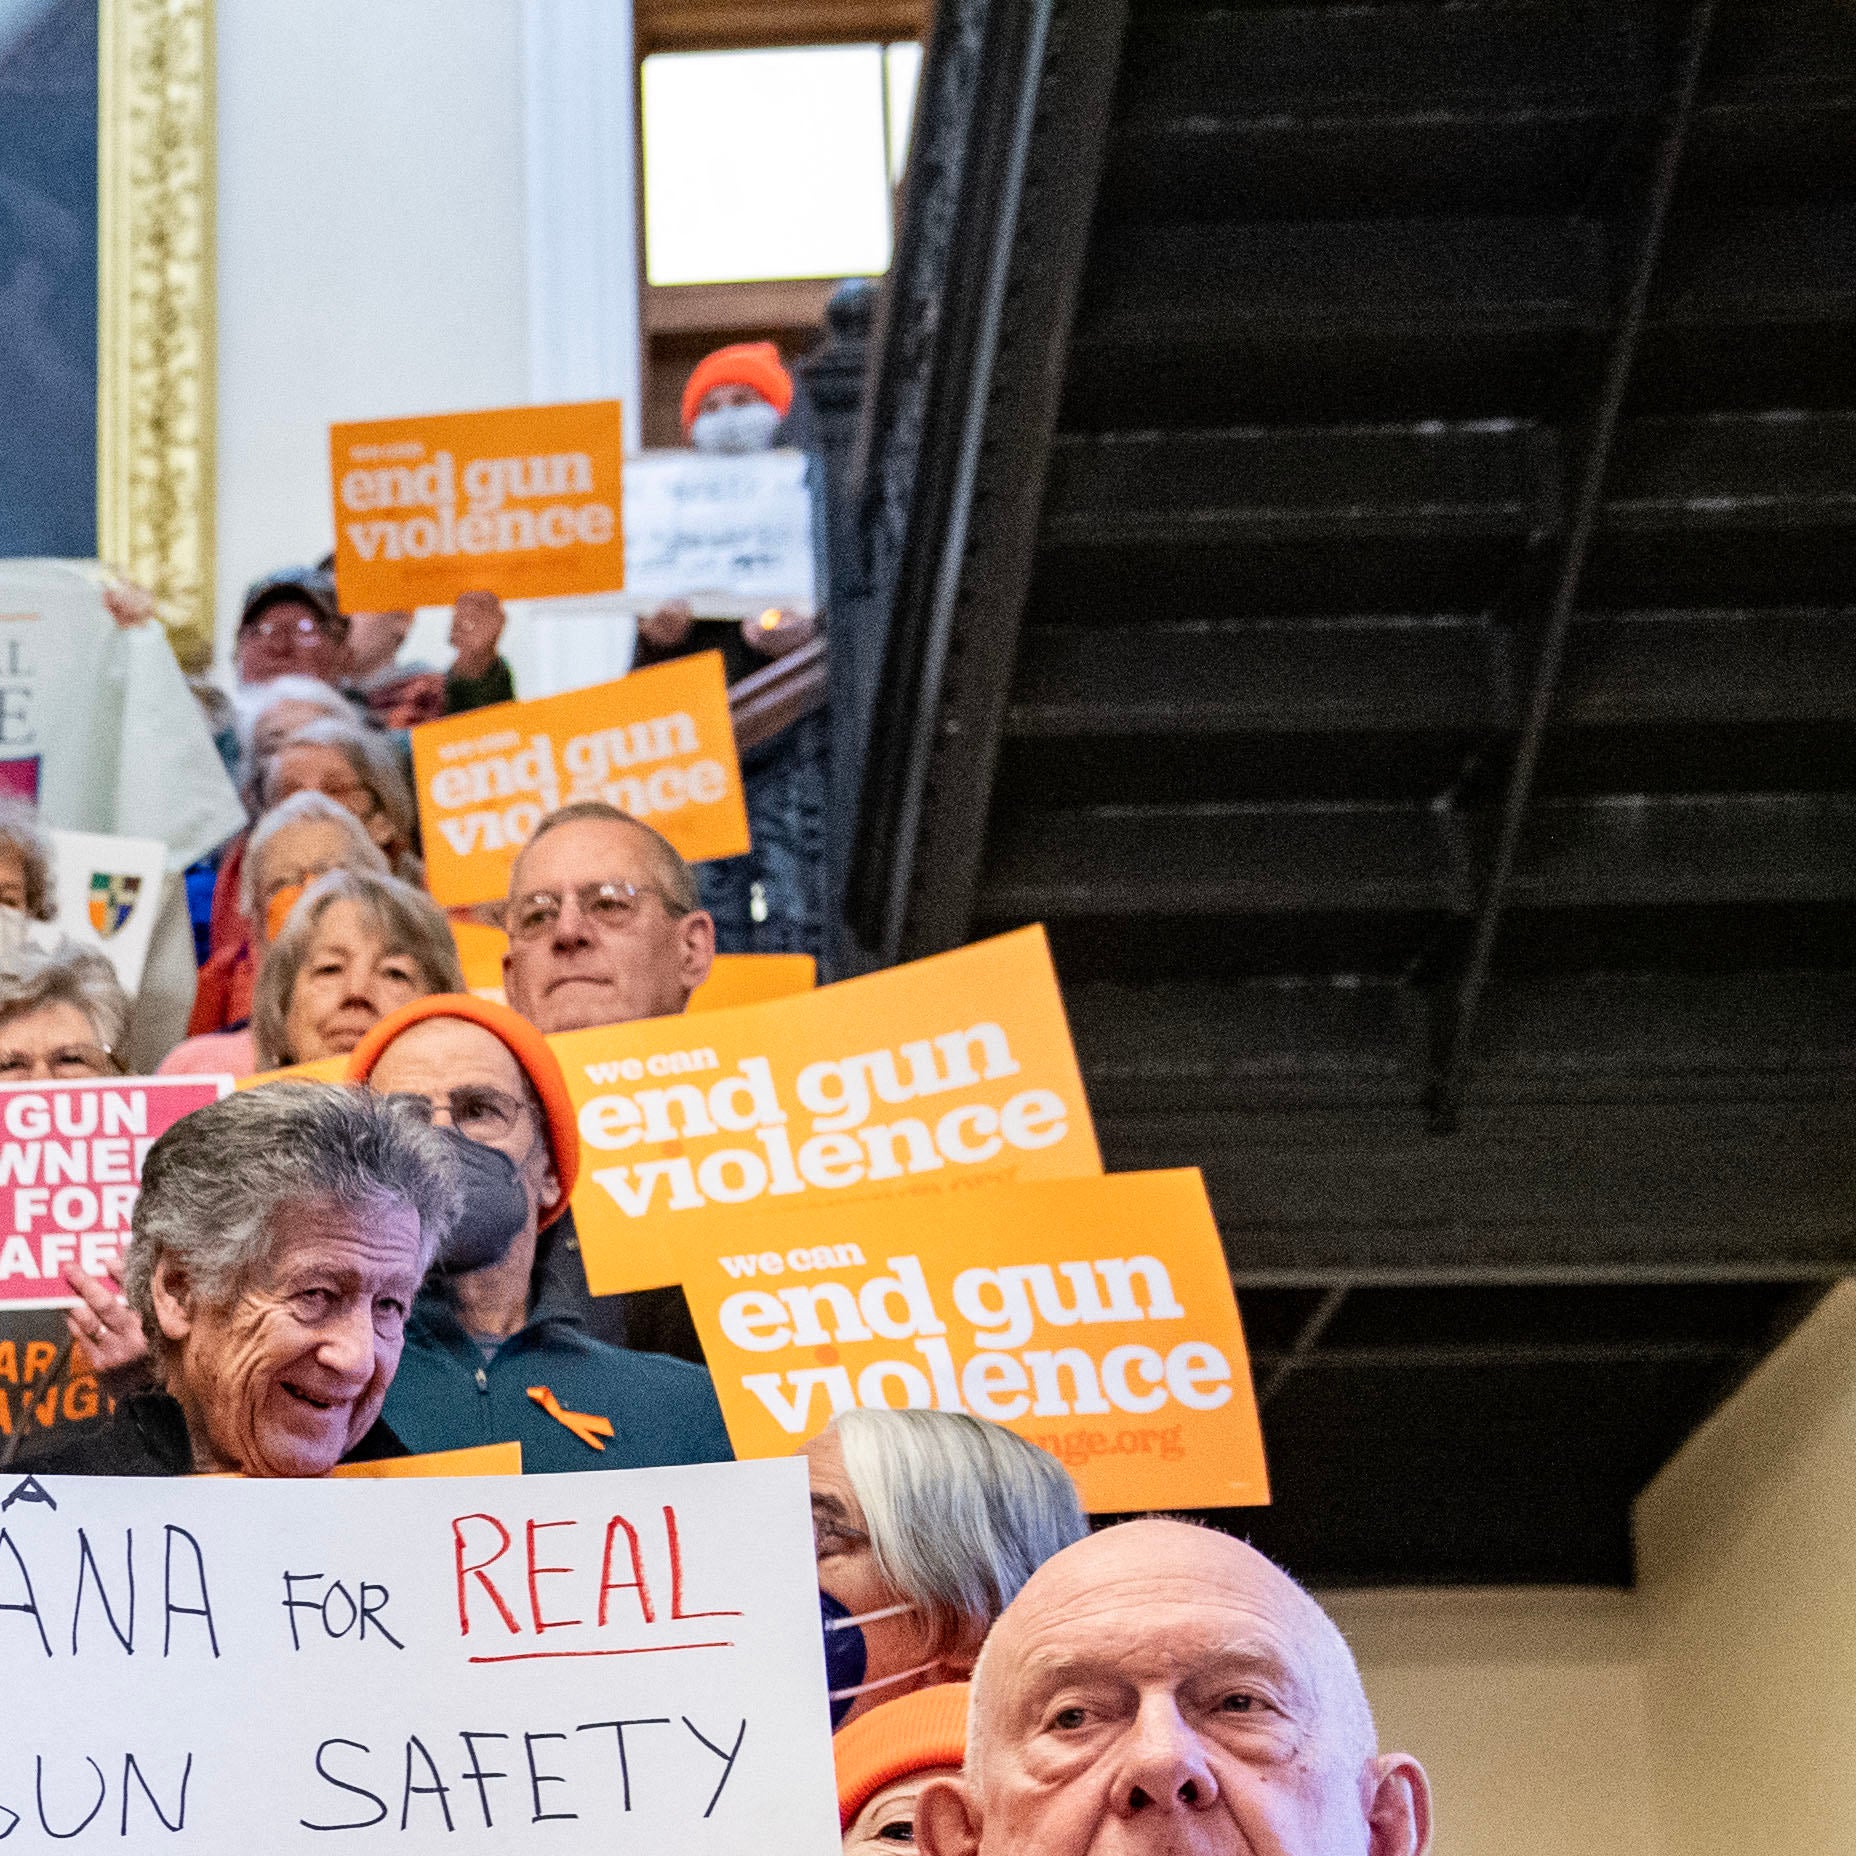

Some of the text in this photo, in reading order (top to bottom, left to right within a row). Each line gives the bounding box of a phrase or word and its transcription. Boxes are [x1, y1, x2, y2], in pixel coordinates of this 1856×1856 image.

[342, 452, 592, 512] end gun
[347, 505, 614, 563] violence
[431, 712, 698, 810] end gun
[578, 1022, 1020, 1151] end gun
[584, 1047, 719, 1085] we can
[5, 1091, 147, 1138] GUN
[592, 1089, 1069, 1218] violence
[15, 1185, 137, 1232] FOR
[719, 1243, 867, 1279] we can
[719, 1255, 1184, 1352] end gun
[283, 1571, 405, 1650] FOR
[455, 1505, 744, 1636] REAL
[300, 1717, 746, 1832] SAFETY
